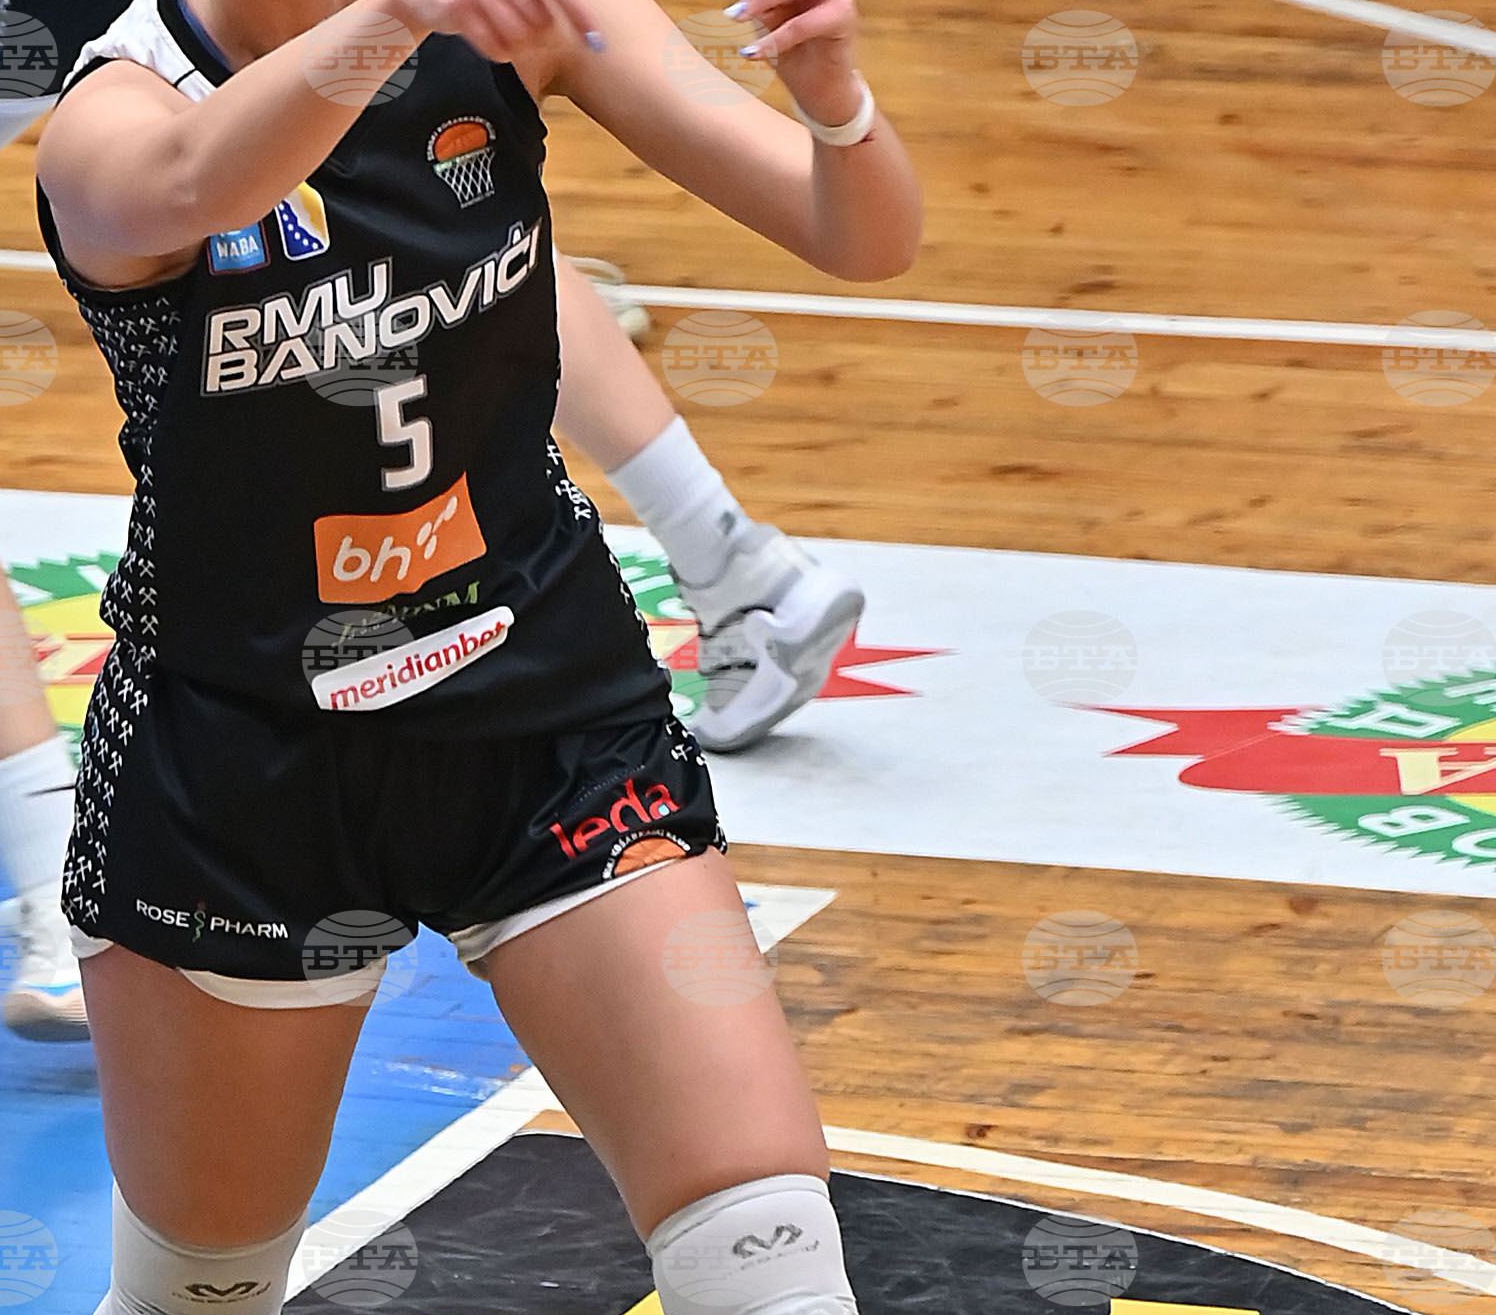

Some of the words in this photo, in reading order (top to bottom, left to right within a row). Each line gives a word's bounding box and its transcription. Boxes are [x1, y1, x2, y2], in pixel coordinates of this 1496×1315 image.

[205, 223, 541, 394] BANOVIĆI
[208, 260, 390, 355] RMU
[375, 376, 434, 492] 5
[332, 535, 412, 583] bh
[329, 620, 506, 711] meridianbet
[550, 777, 681, 861] leda
[136, 898, 191, 929] ROSE
[209, 915, 289, 940] PHARM
